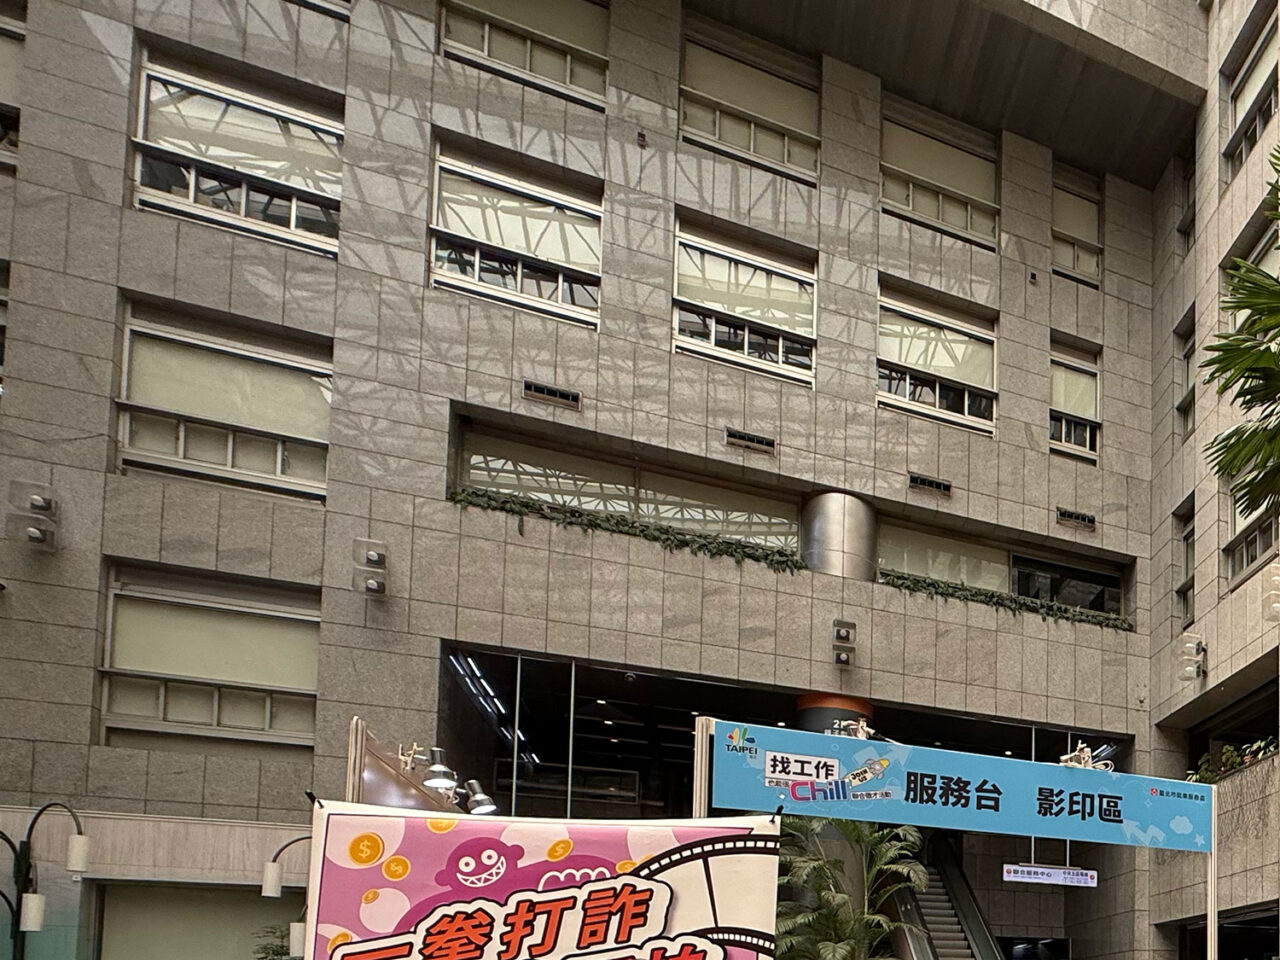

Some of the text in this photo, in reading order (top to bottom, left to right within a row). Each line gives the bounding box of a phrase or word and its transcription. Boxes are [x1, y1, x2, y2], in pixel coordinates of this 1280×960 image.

[725, 744, 758, 755] TAIPEI
[770, 755, 835, 780] 找工作
[851, 768, 868, 780] JOIN
[790, 780, 848, 801] Chill
[905, 771, 1124, 824] 服務台 影印區
